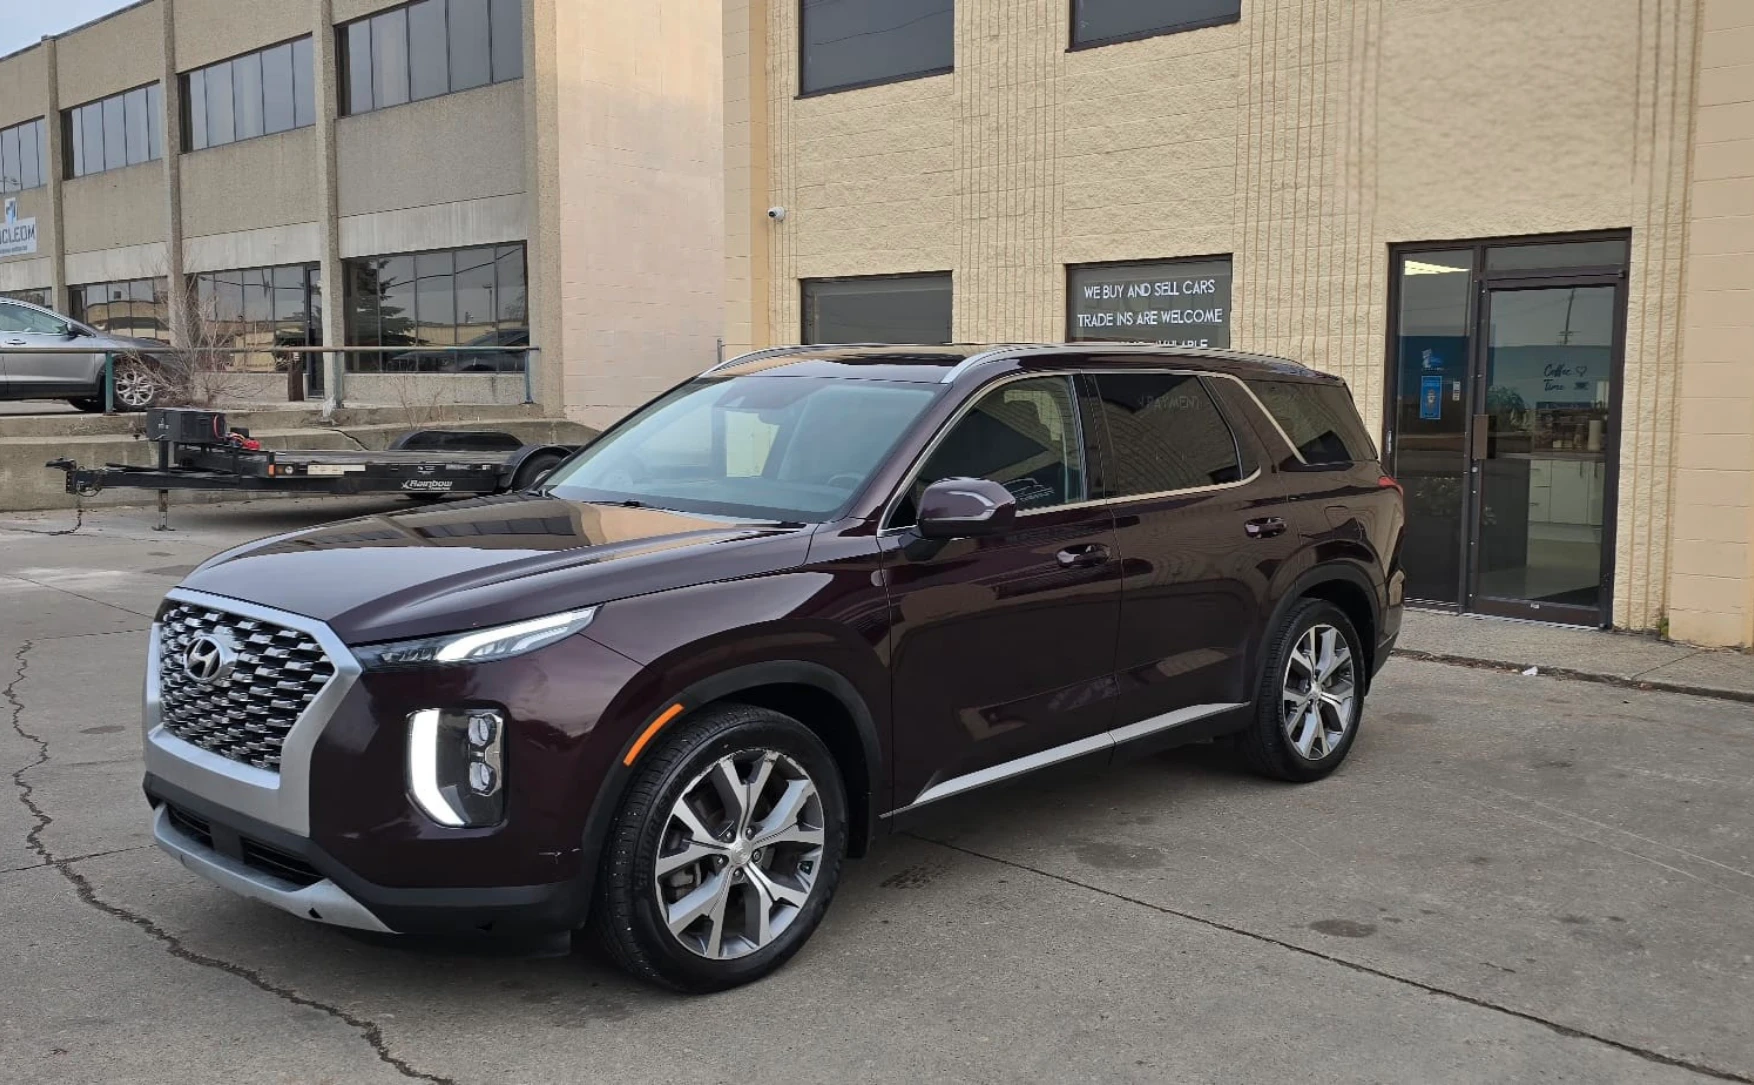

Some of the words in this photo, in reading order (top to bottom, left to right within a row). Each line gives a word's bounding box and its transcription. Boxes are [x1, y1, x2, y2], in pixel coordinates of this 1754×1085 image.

[1084, 285, 1101, 299] WE
[1103, 284, 1124, 298] BUY
[1127, 282, 1151, 297] AND
[1154, 281, 1180, 297] SELL
[1183, 279, 1216, 295] CARS
[1077, 312, 1114, 328] TRADE
[1116, 311, 1134, 326] INS
[1136, 310, 1158, 325] ARE
[1160, 308, 1223, 324] WELCOME
[1543, 363, 1572, 378] Coffee
[1543, 378, 1564, 392] Time
[410, 480, 453, 488] Rainbow
